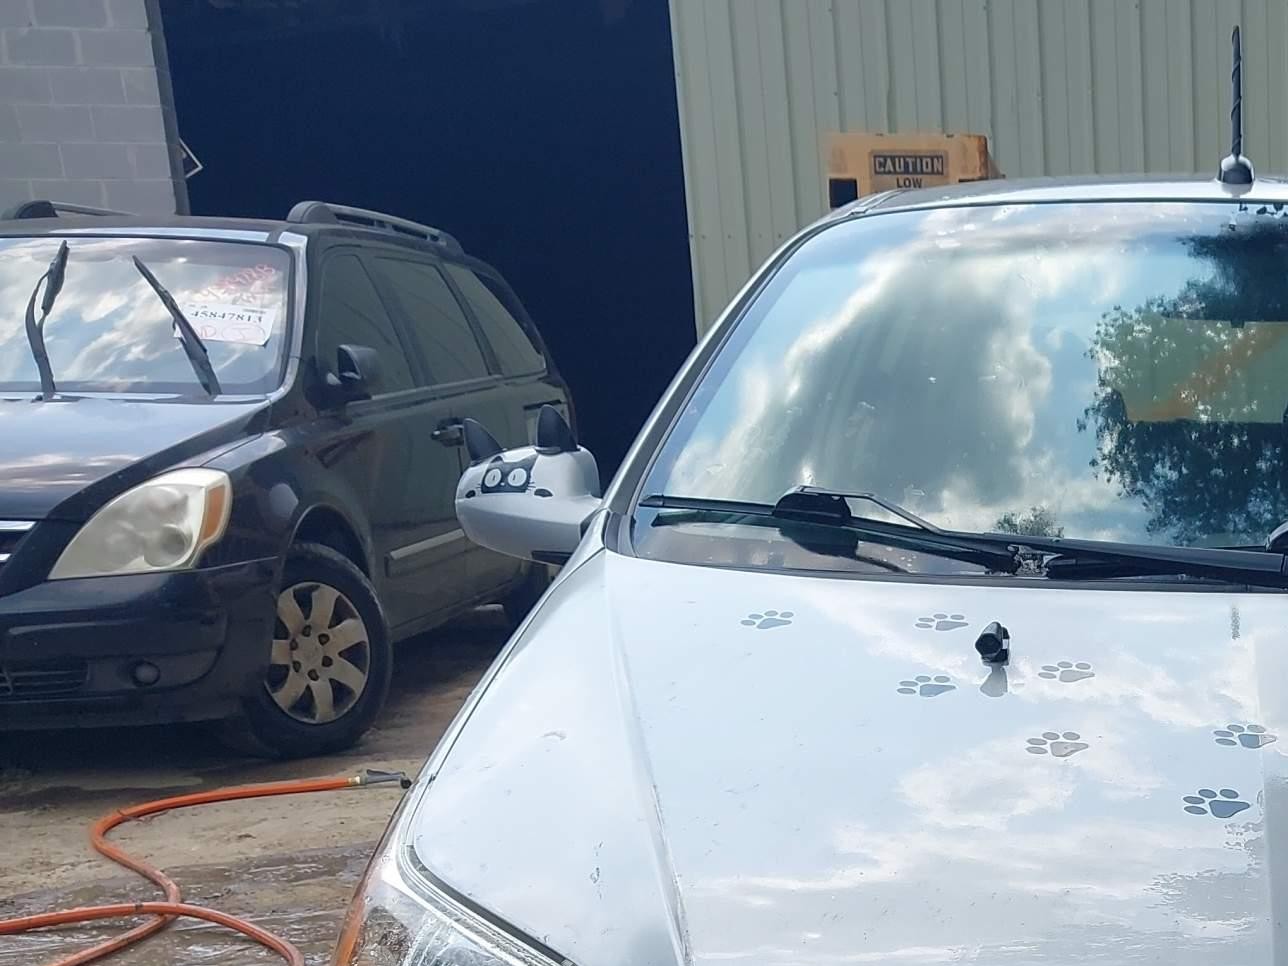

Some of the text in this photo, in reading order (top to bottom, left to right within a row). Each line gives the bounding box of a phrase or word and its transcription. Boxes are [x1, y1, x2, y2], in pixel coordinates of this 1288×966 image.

[875, 156, 943, 173] CAUTION
[896, 177, 923, 189] LOW
[190, 310, 263, 323] 45847813
